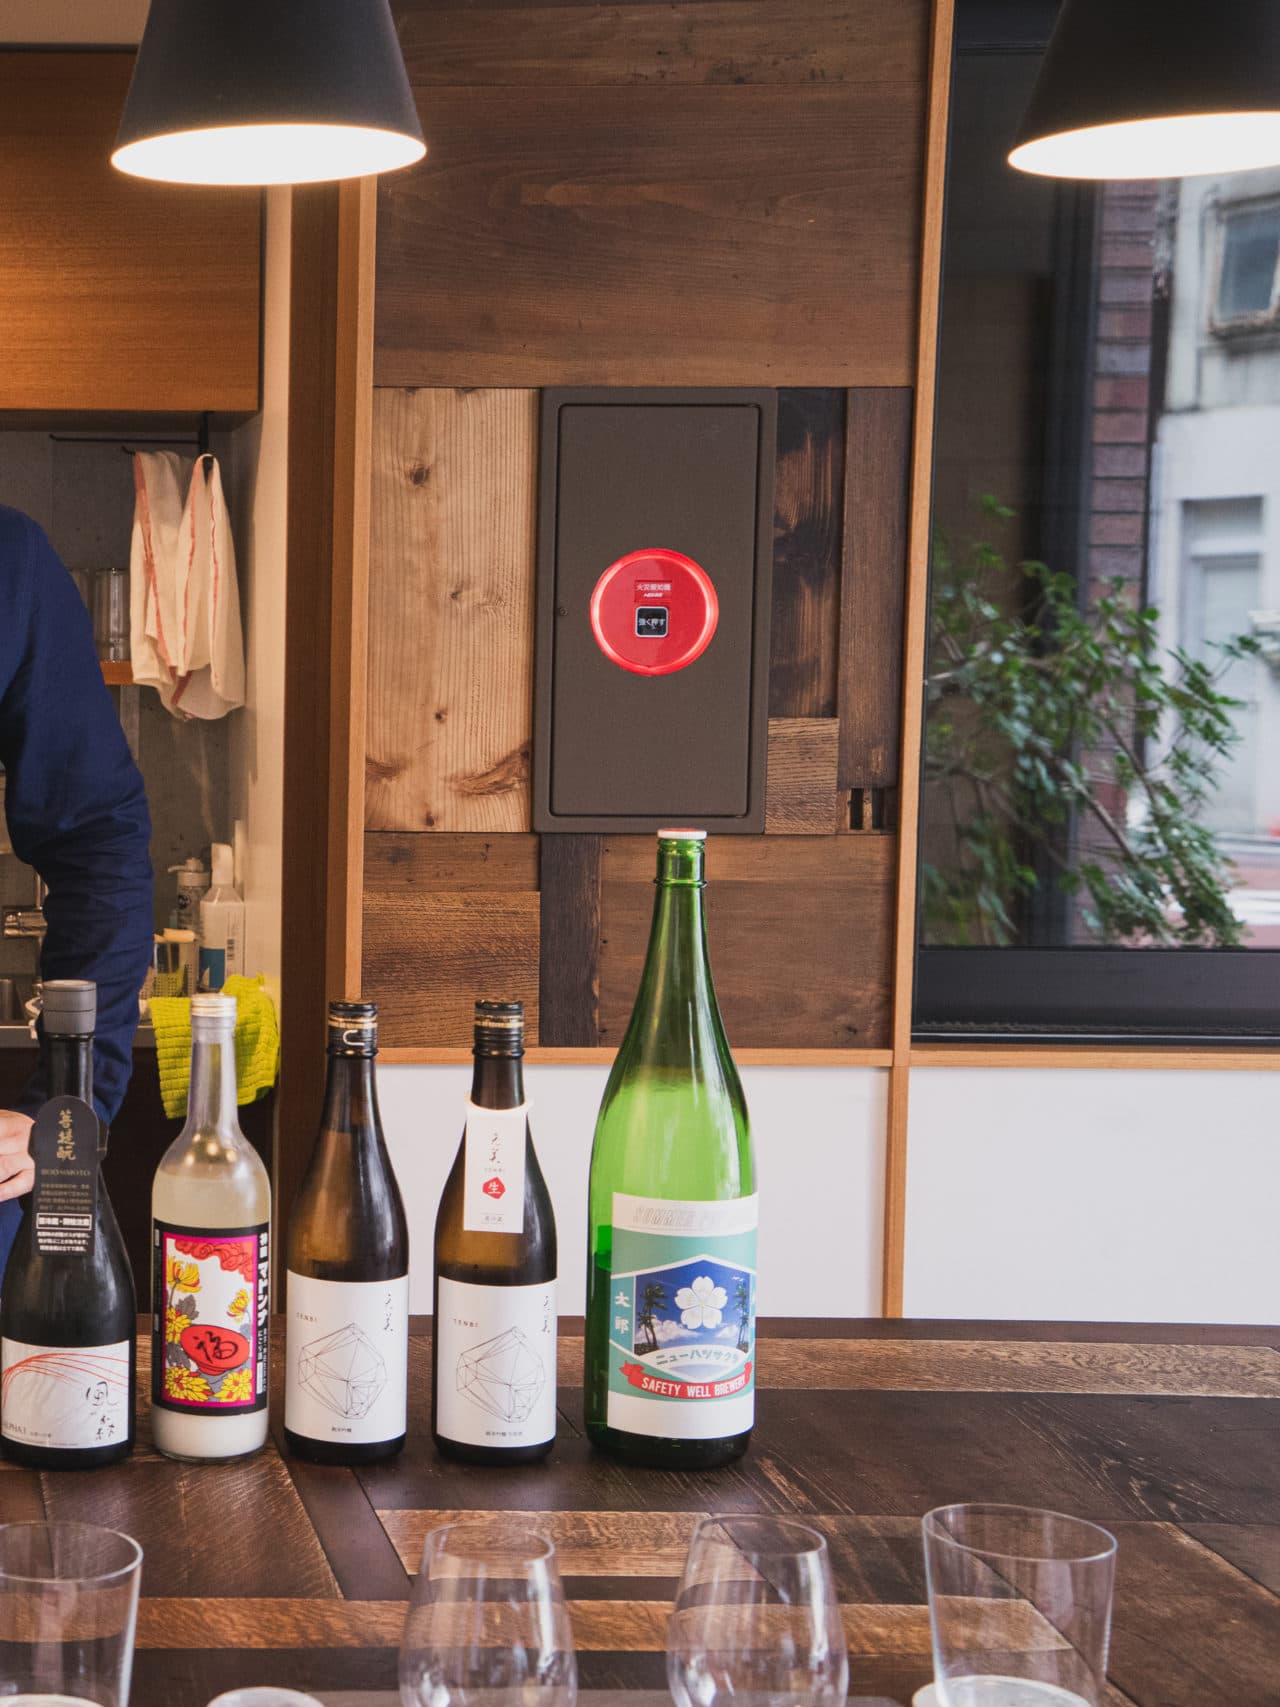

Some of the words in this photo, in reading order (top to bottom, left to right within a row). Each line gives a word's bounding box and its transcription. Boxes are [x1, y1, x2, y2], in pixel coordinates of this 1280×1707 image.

[488, 1181, 502, 1193] 生
[641, 1377, 682, 1396] SAFETY
[687, 1385, 712, 1397] WELL
[715, 1376, 745, 1396] BREWERY
